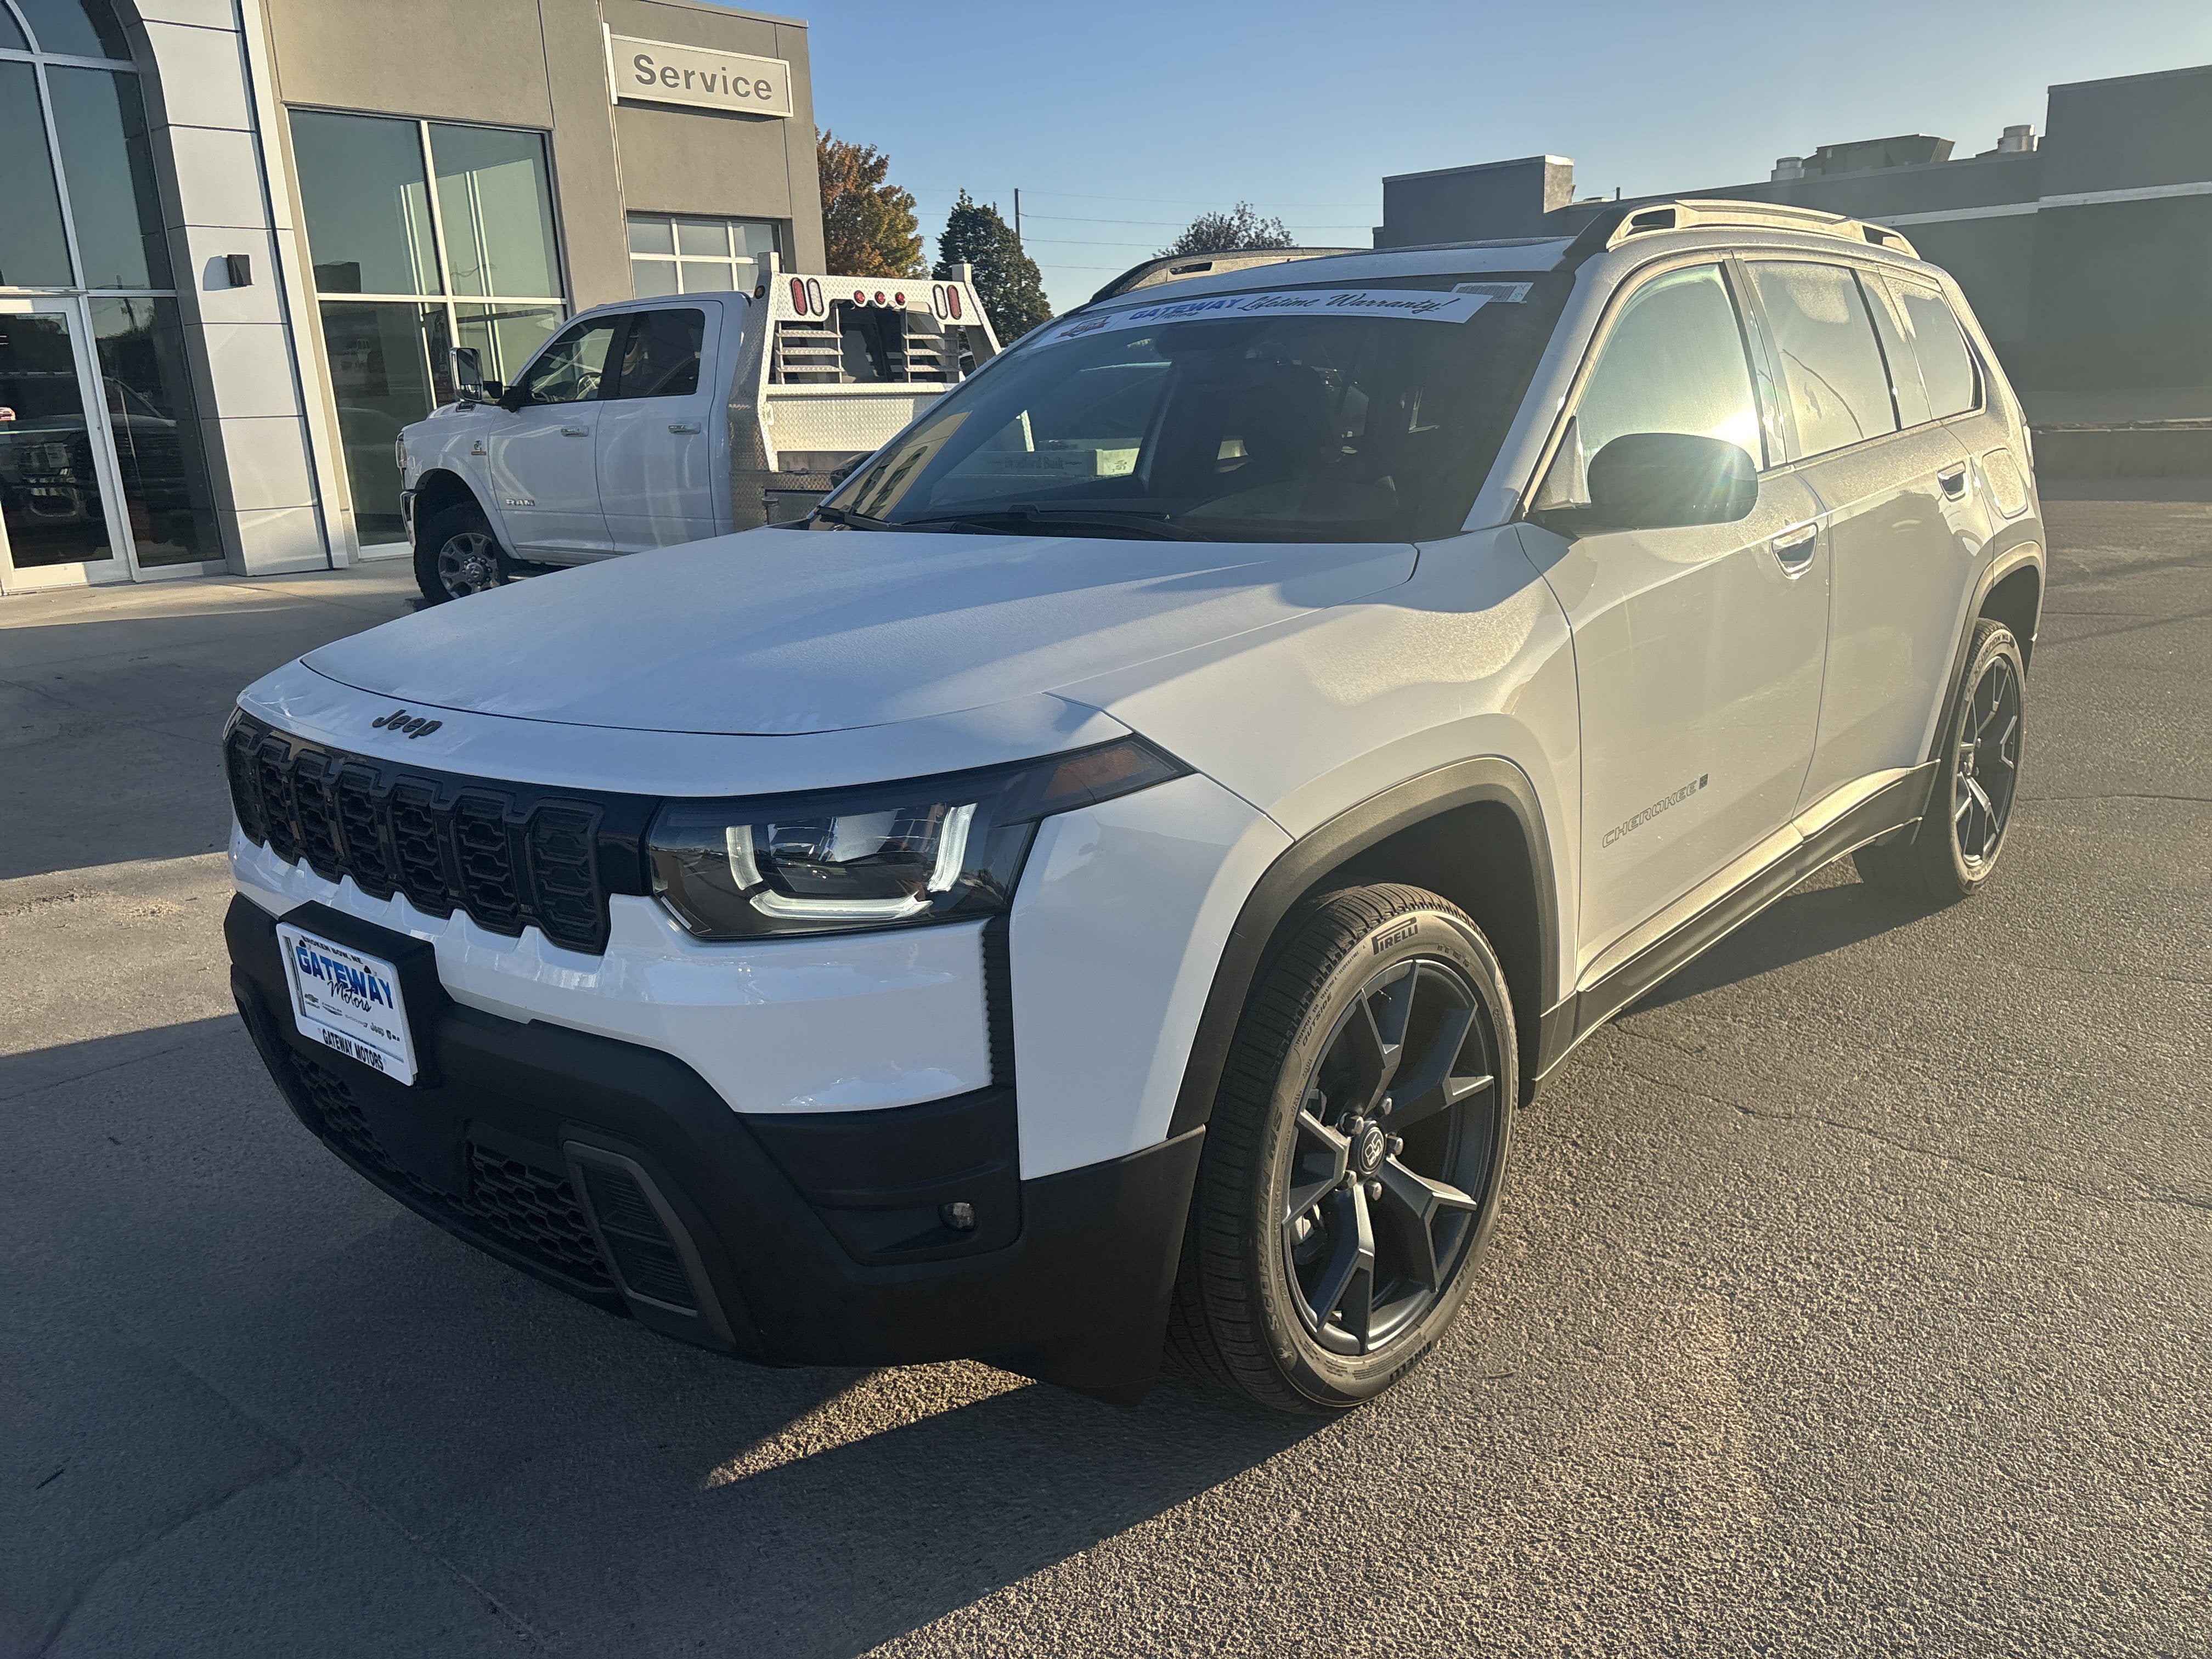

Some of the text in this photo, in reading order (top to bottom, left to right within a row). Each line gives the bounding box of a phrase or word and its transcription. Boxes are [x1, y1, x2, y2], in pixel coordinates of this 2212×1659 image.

[634, 54, 772, 100] Service
[1128, 293, 1460, 320] GATEWAY Lifetime Warranty!
[506, 498, 535, 506] RAM
[372, 709, 443, 739] Jeep
[1602, 780, 1697, 848] CHEROKEE
[301, 934, 332, 952] BROKEN
[351, 955, 363, 964] NE
[1371, 916, 1418, 956] PIRELLI
[296, 946, 394, 1010] GATEWAY
[328, 980, 372, 1012] Motors
[1302, 991, 1332, 1046] OUTSIDE
[322, 1028, 353, 1056] GATEWAY
[356, 1042, 385, 1071] MOTORS
